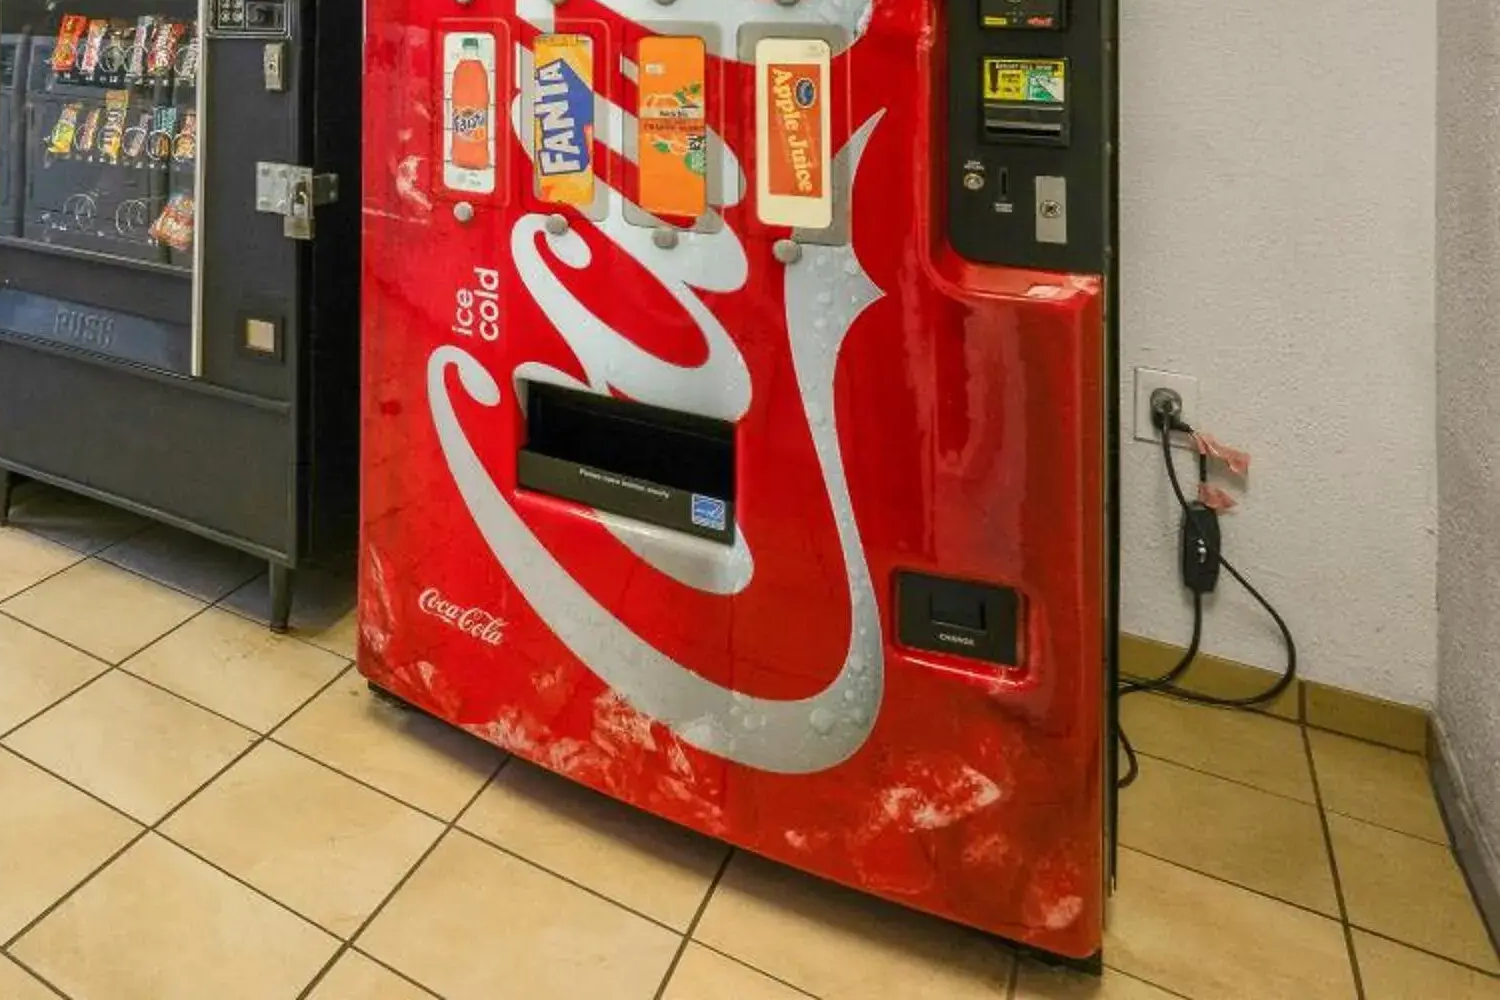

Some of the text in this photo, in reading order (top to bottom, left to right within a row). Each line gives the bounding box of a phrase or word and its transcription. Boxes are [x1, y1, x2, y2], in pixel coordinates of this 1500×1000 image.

[534, 62, 582, 174] FANTA
[771, 67, 813, 192] Apple Juice
[53, 310, 117, 350] PUSH
[451, 288, 474, 337] ice
[473, 265, 499, 341] cold
